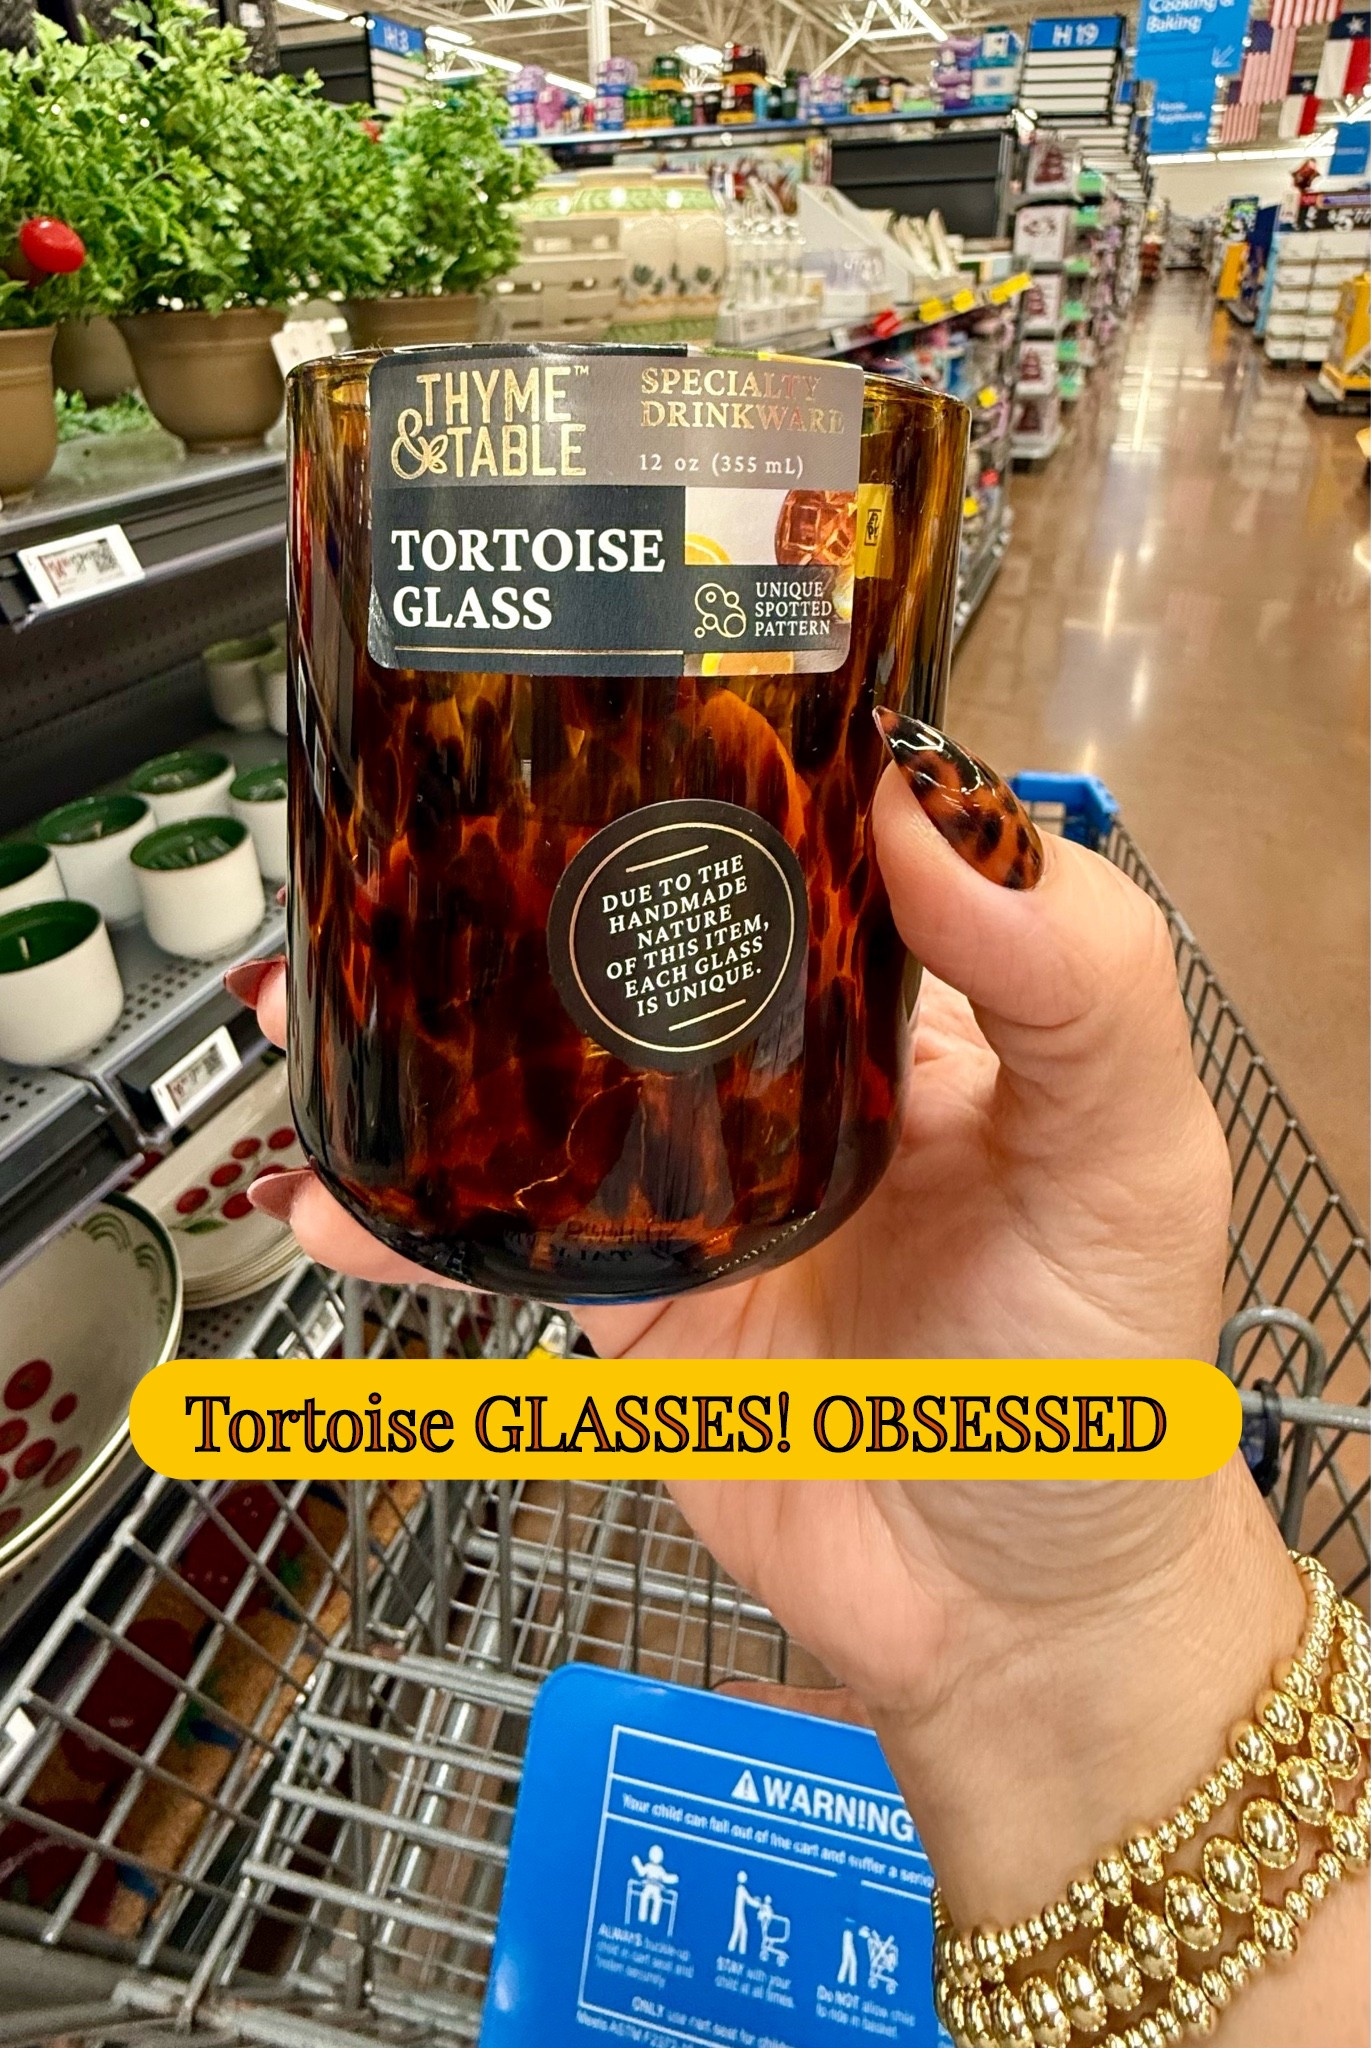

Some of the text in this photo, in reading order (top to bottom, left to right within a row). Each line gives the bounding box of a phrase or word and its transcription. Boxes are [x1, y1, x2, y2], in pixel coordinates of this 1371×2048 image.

[641, 367, 821, 401] SPECIALTY
[640, 400, 844, 434] DRINKWARE
[447, 423, 587, 478] TABLE
[640, 452, 803, 479] 12 oz (355 mL)
[391, 528, 665, 573] TORTOISE
[393, 586, 553, 630] GLASS
[755, 601, 832, 617] SPOTTED
[756, 581, 824, 600] UNIQUE
[755, 620, 830, 637] PATTERN
[602, 854, 744, 913] DUE TO THE
[609, 875, 748, 934] HANDMADE
[606, 913, 769, 980] OF THIS ITEM,
[637, 904, 732, 950] NATURE
[625, 936, 763, 998] EACH GLASS
[637, 962, 761, 1018] IS UNIQUE.
[651, 1803, 684, 1823] child
[763, 1775, 915, 1843] WARNING
